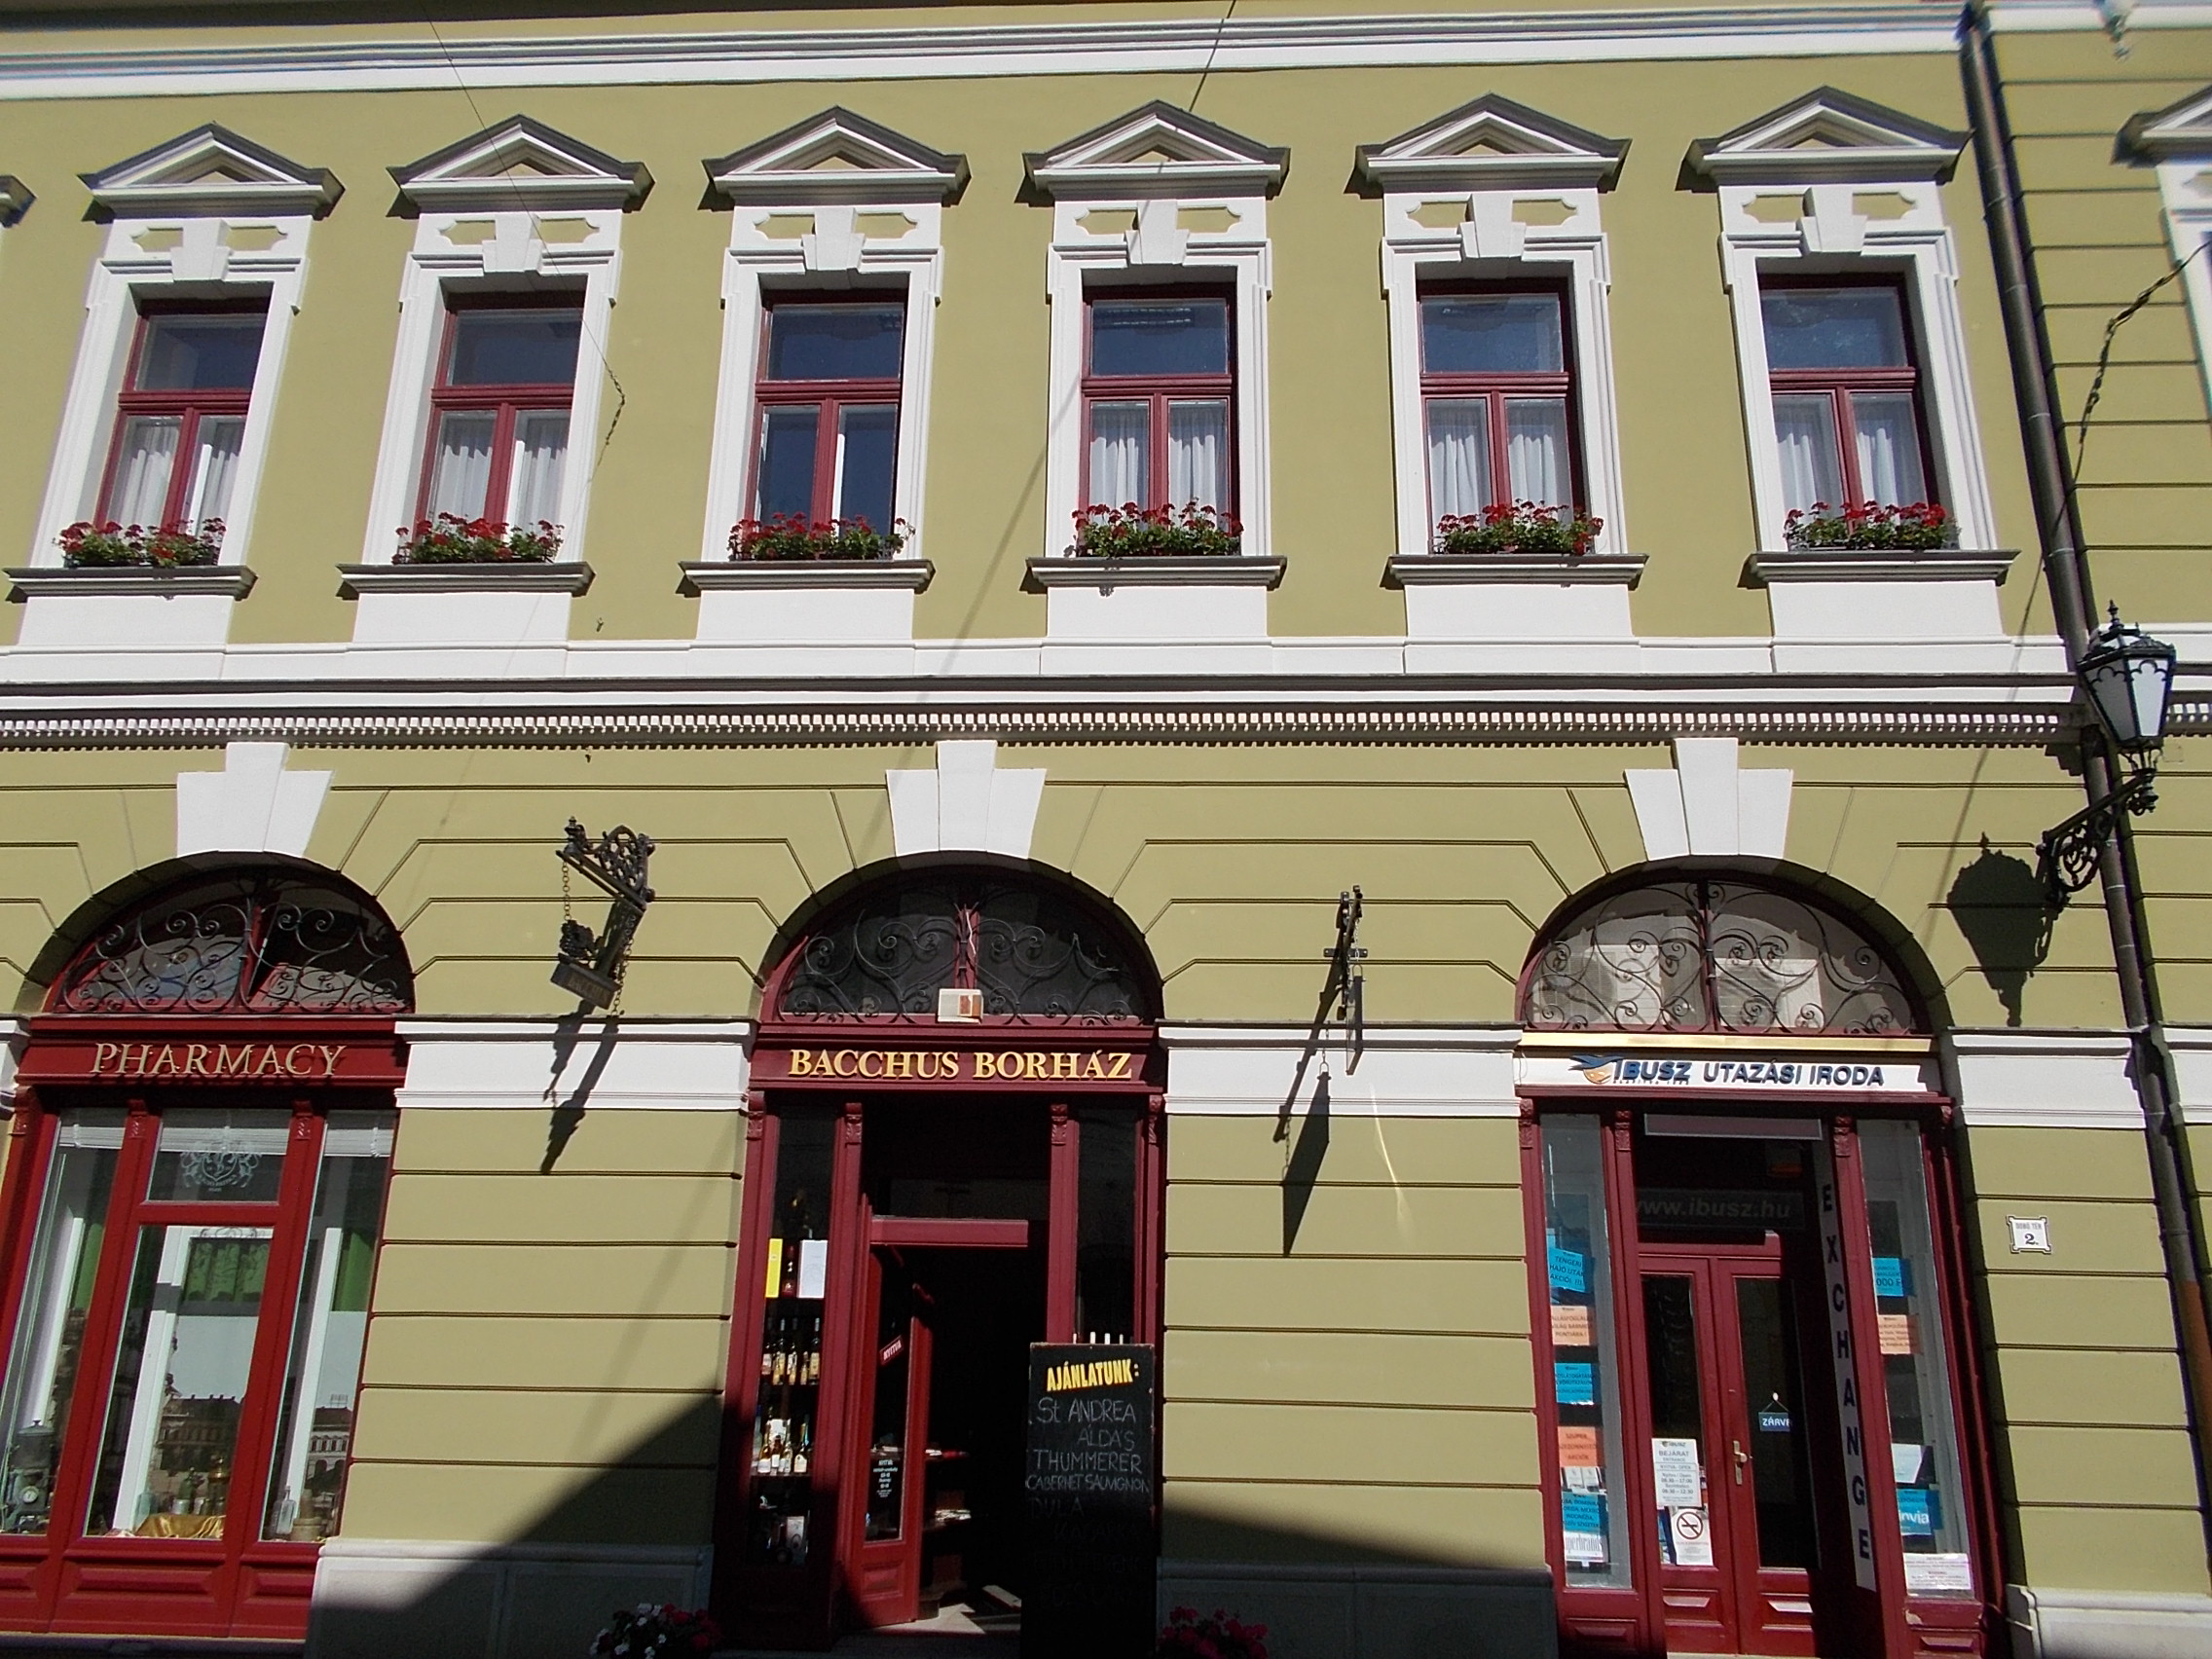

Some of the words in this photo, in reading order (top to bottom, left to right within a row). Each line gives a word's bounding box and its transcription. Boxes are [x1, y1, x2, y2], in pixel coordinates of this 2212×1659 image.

[90, 1043, 347, 1076] PHARMACY
[788, 1049, 960, 1079] BACCHUS
[973, 1050, 1133, 1081] BORHÁZ
[1612, 1058, 1693, 1082] IBUSZ
[1703, 1056, 1802, 1085] UTAZÁSI
[1809, 1064, 1885, 1087] IRODA
[2024, 1233, 2039, 1245] 2.
[1046, 1359, 1139, 1392] AJÁNLATUNK:
[1822, 1184, 1871, 1561] EXCHANGE
[1068, 1398, 1136, 1423] ANDREA
[1033, 1449, 1143, 1474] THUMMERER
[1024, 1473, 1084, 1492] CABERNET
